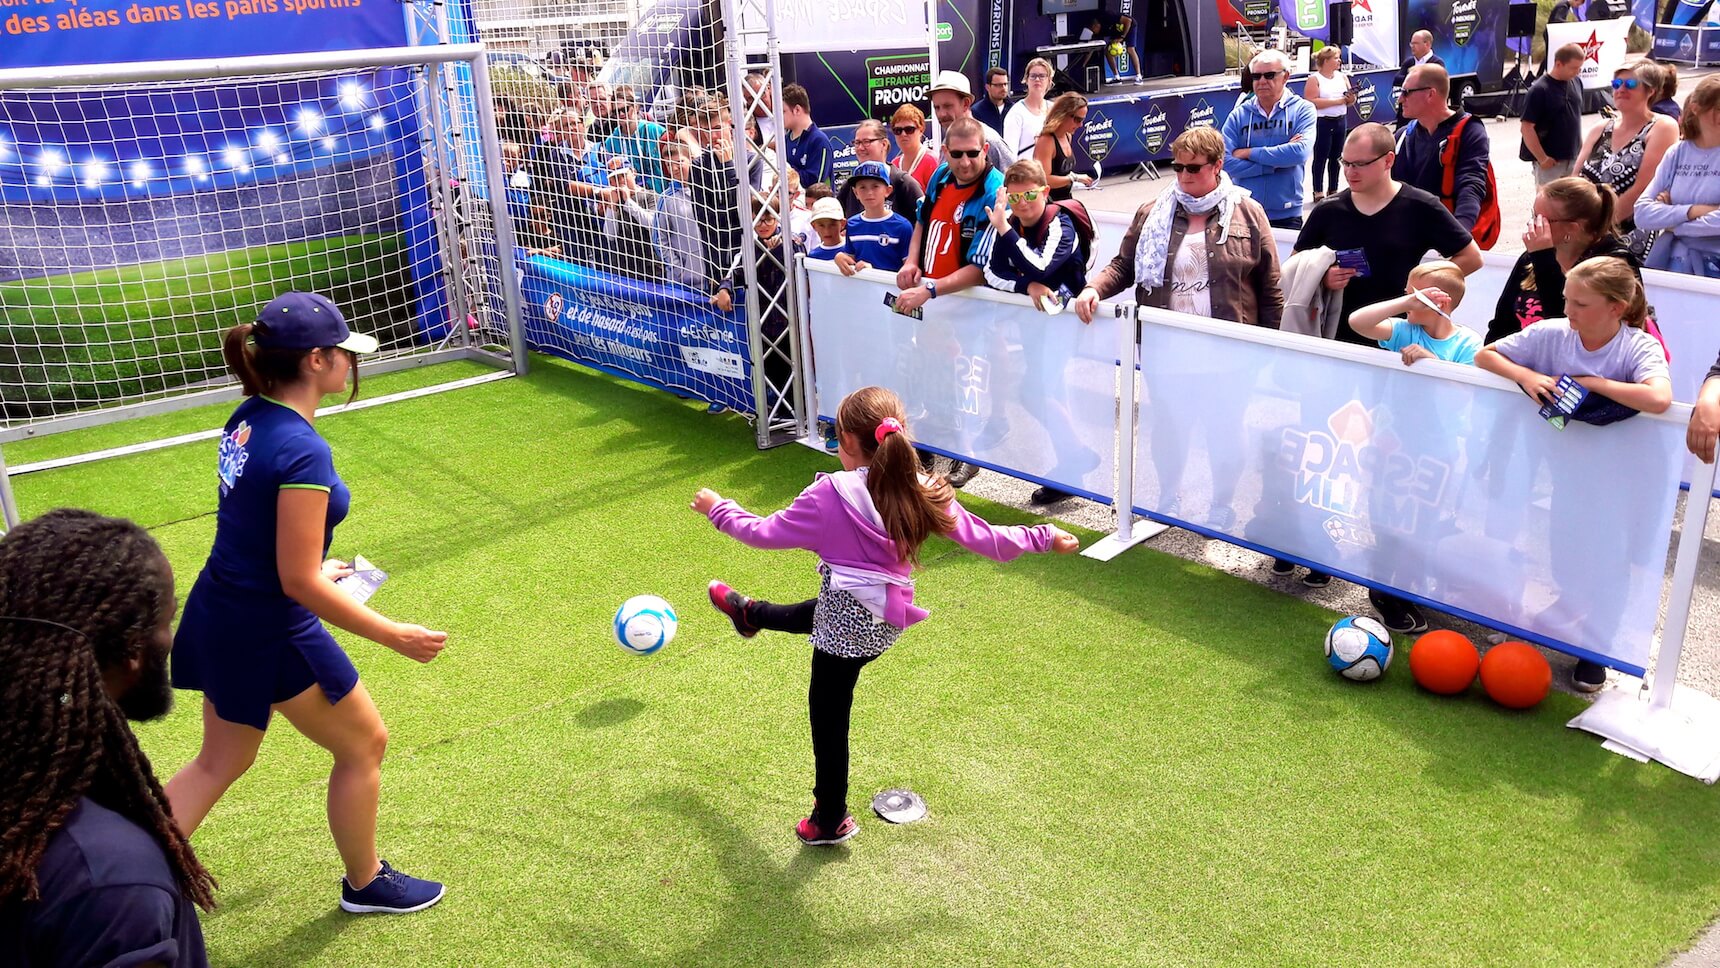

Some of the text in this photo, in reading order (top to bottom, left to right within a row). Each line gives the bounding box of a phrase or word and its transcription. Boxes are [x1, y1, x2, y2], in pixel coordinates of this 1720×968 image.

[5, 13, 51, 35] des
[56, 7, 120, 30] aléas
[125, 3, 182, 24] dans
[185, 0, 220, 19] les
[225, 0, 278, 21] paris
[874, 63, 930, 75] CHAMPIONNAT
[885, 75, 920, 86] FRANCE
[875, 85, 930, 105] PRONOS
[833, 145, 856, 158] RNÉE
[566, 304, 578, 320] et
[578, 307, 592, 325] de
[591, 310, 628, 334] hasard
[642, 329, 657, 343] pas
[607, 338, 652, 362] mineurs
